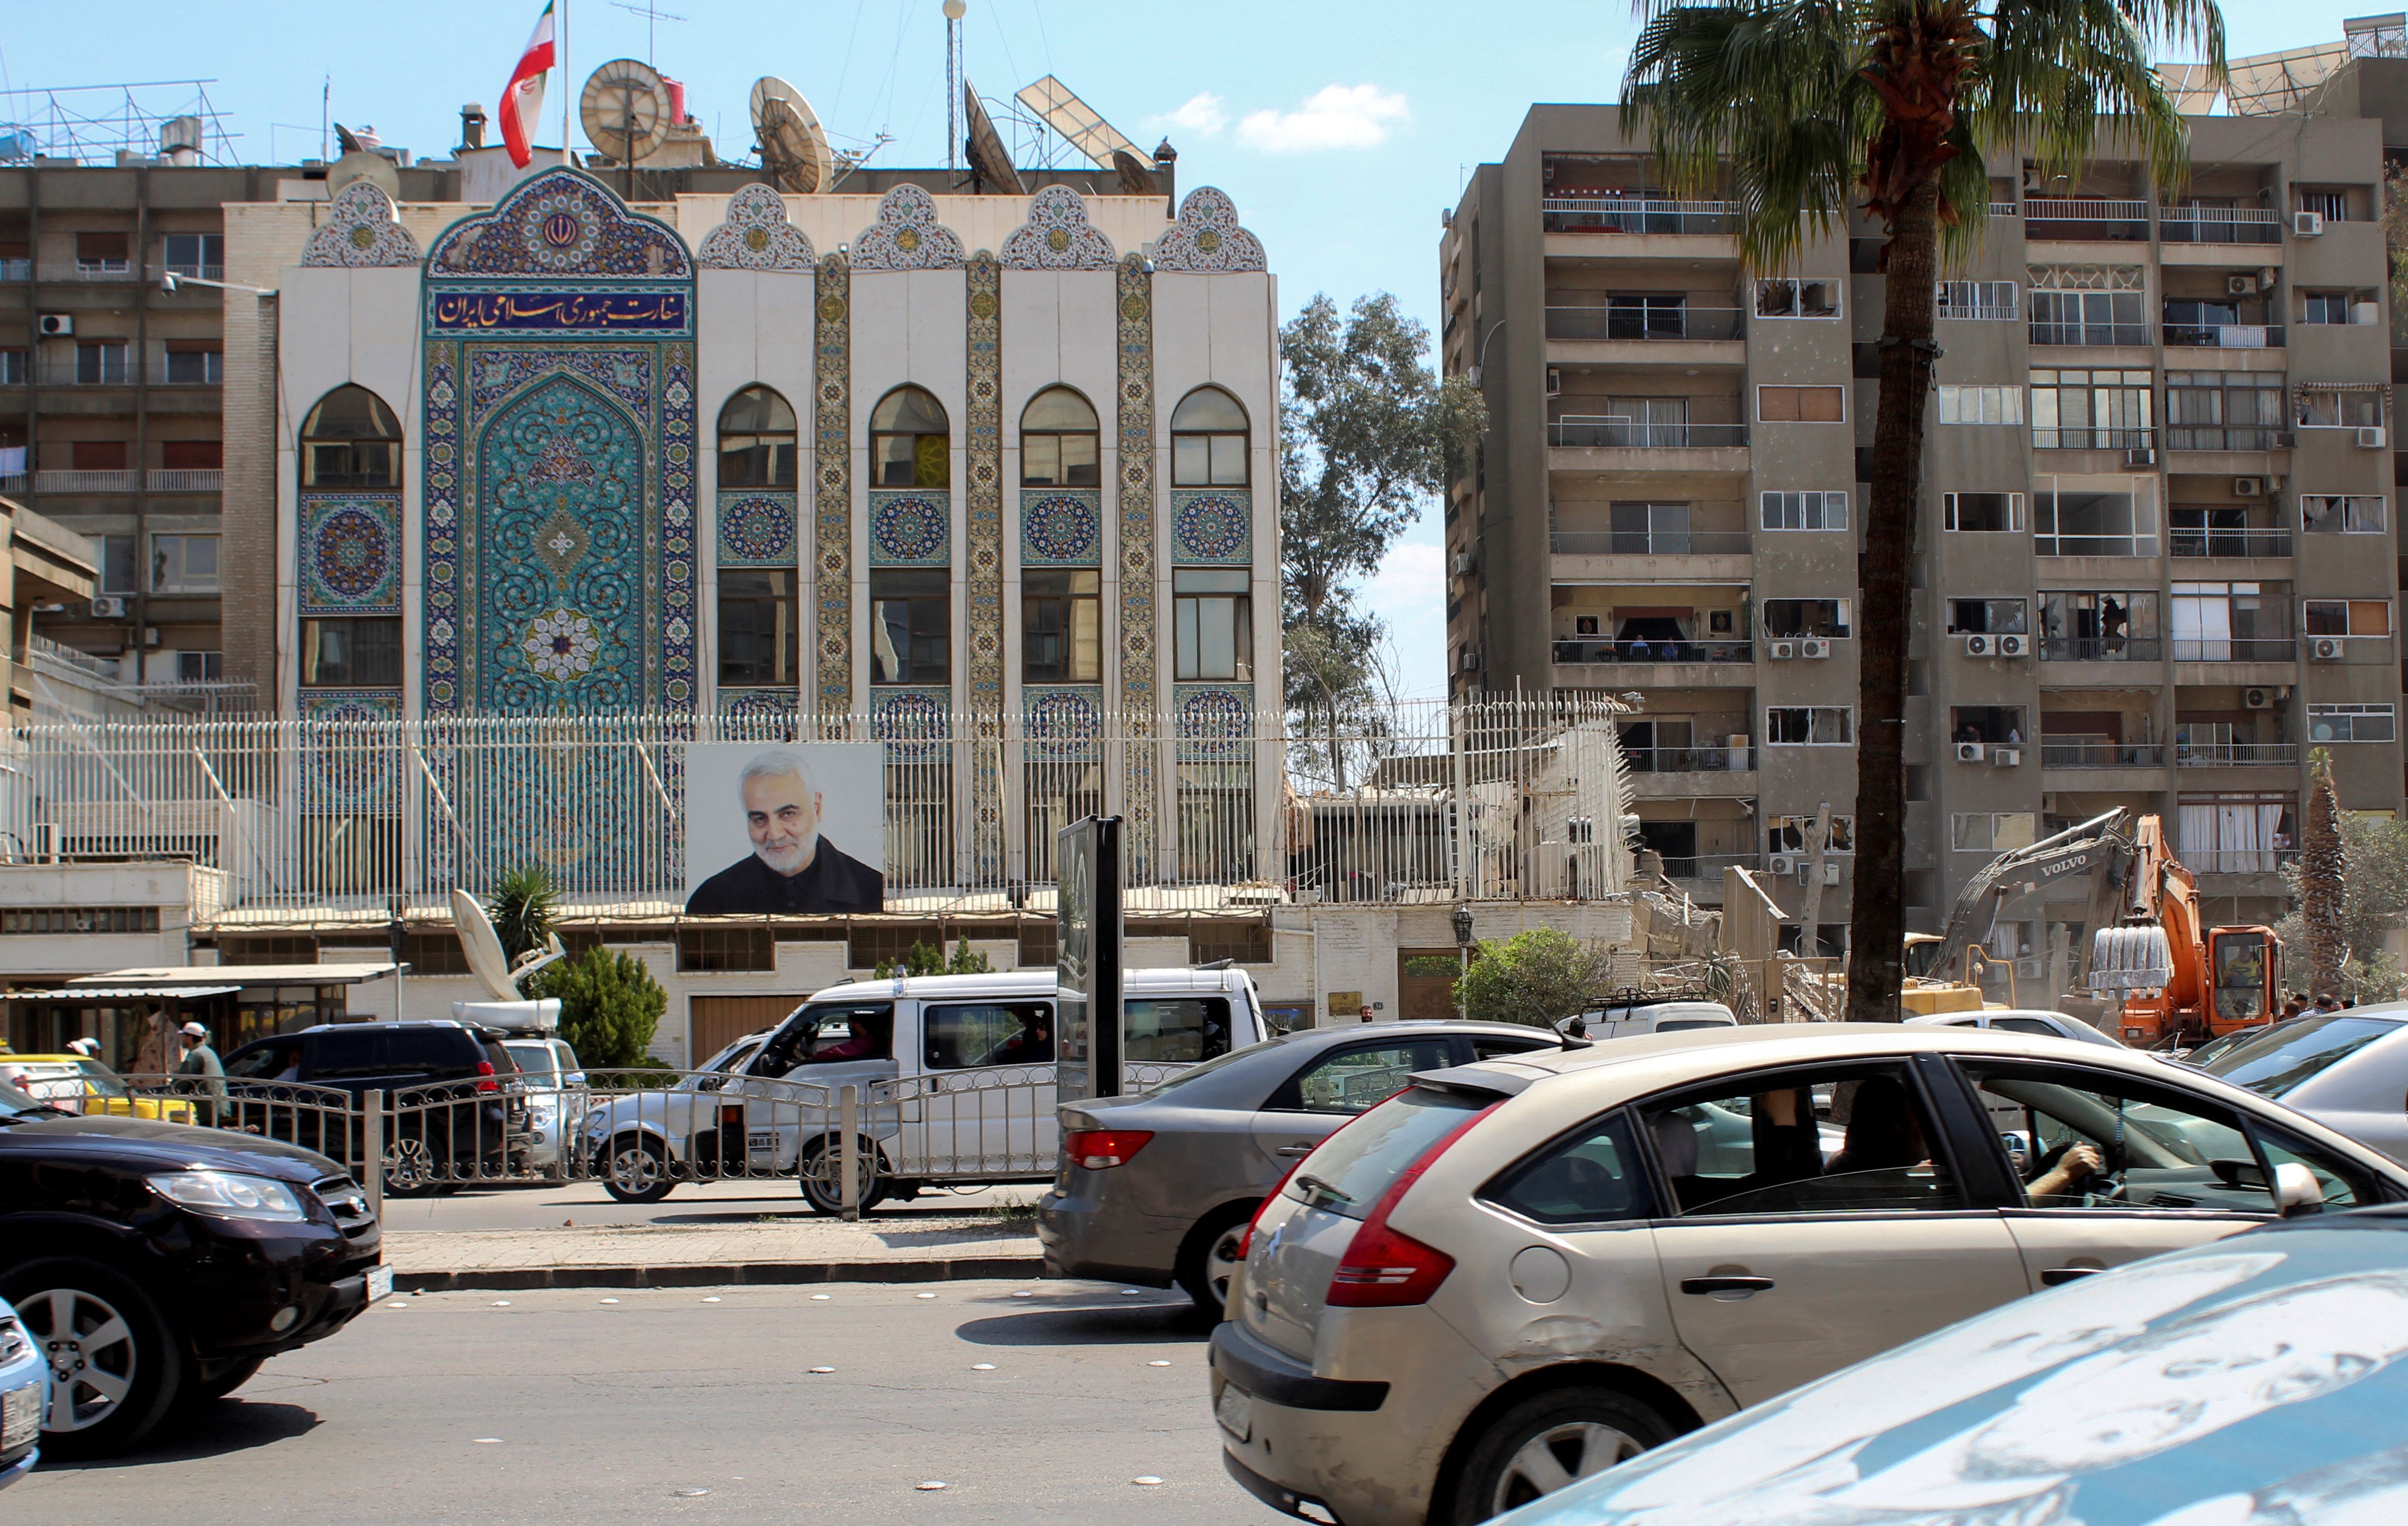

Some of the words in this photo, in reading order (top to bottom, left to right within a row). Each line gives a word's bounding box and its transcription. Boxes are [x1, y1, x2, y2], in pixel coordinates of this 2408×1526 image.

[438, 297, 482, 327] ایران
[480, 295, 563, 326] اسلامی
[561, 296, 612, 326] جمهوری
[607, 297, 679, 321] سفارت
[2040, 854, 2087, 877] VOLVO
